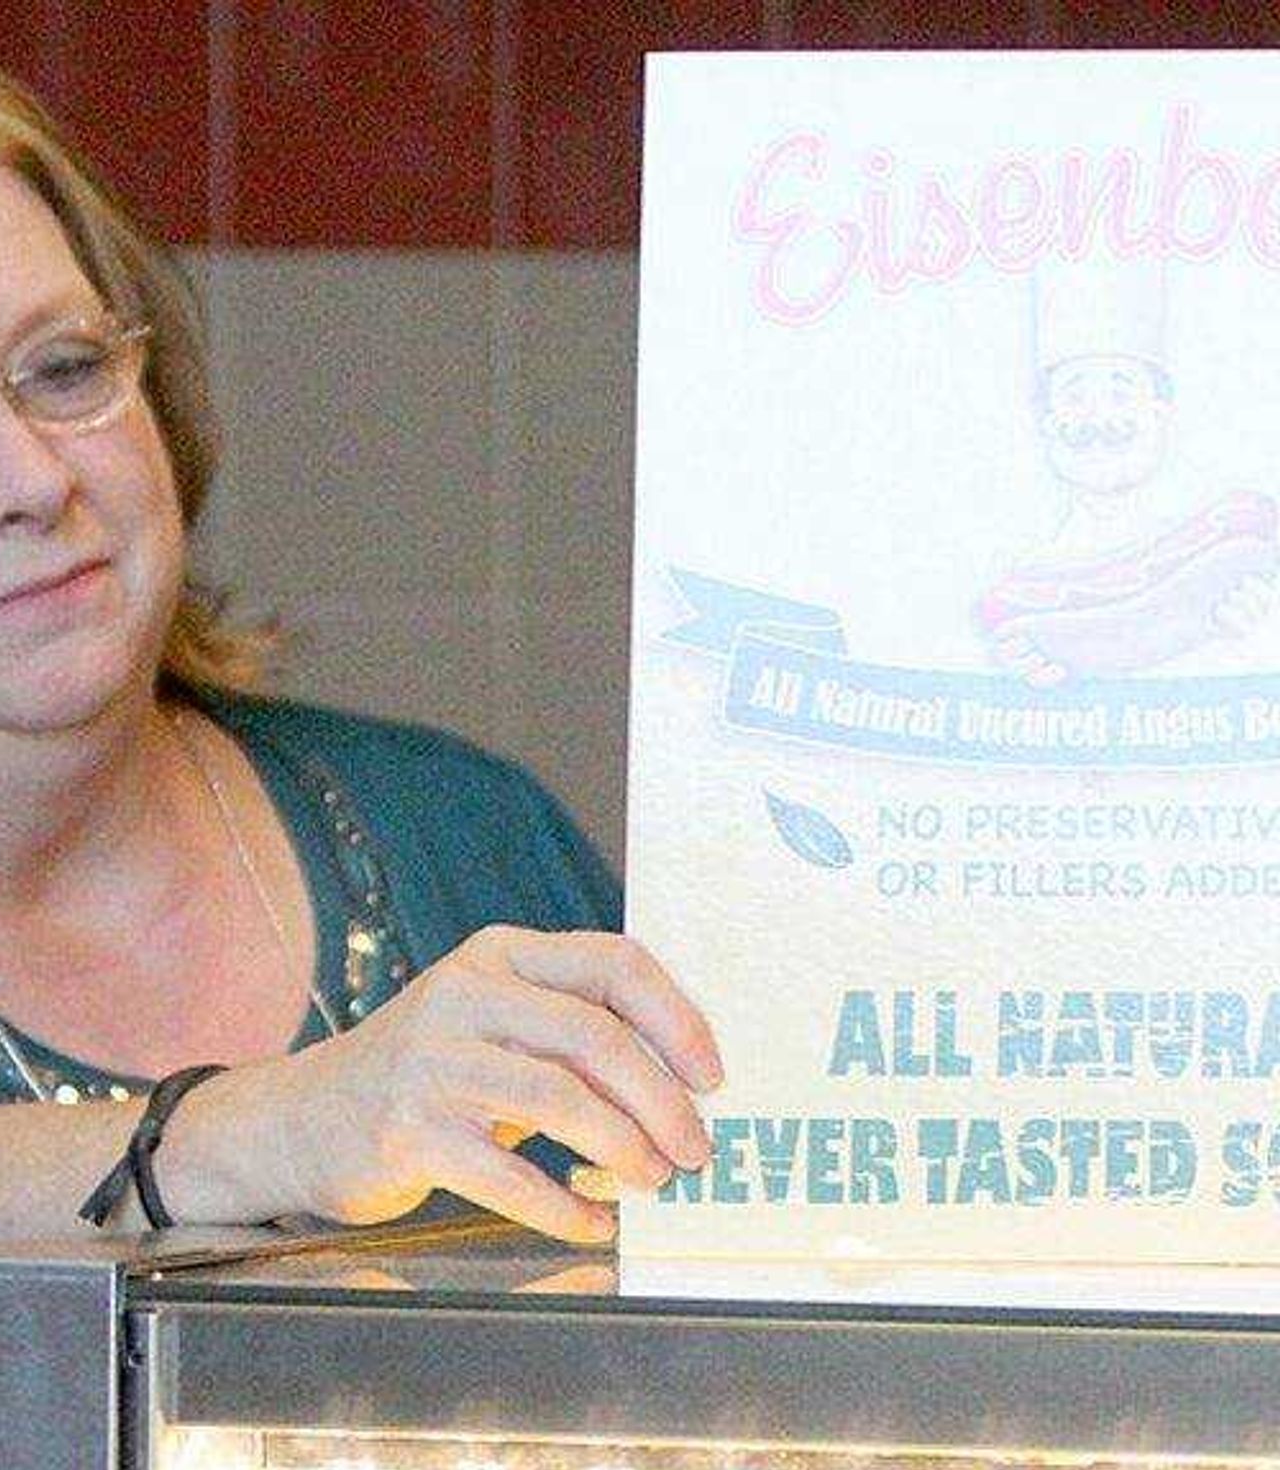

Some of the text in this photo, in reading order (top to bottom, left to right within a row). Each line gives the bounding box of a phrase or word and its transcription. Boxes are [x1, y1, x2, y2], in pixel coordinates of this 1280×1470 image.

[813, 679, 945, 738] Natural
[877, 804, 940, 842] NO
[877, 862, 937, 899] OR
[963, 864, 1147, 899] FILLERS
[830, 990, 973, 1076] ALL
[917, 1118, 1198, 1203] TASTED
